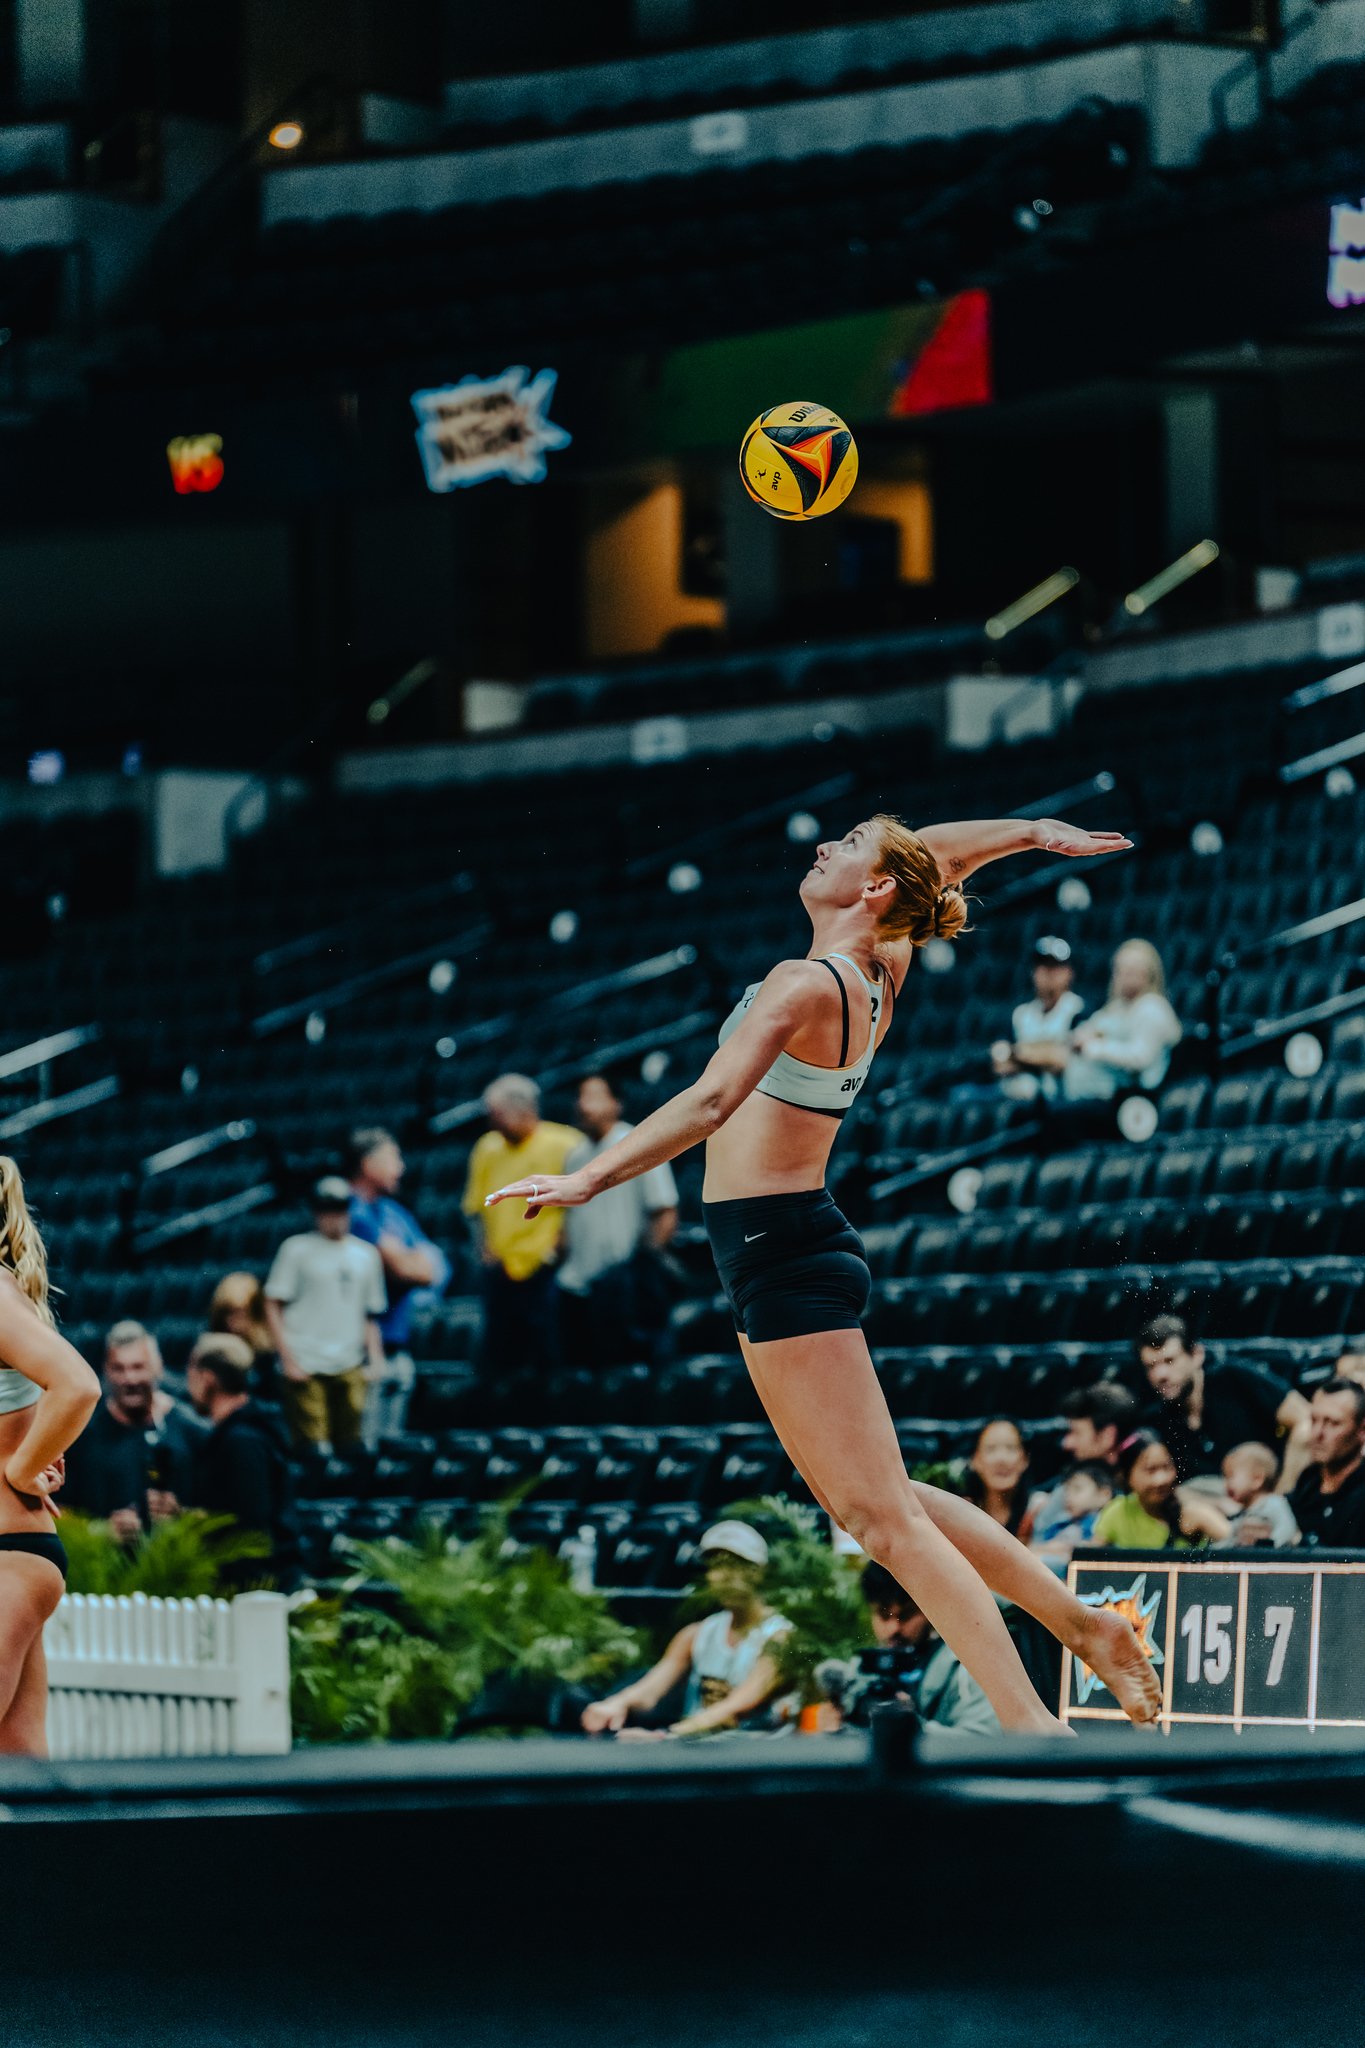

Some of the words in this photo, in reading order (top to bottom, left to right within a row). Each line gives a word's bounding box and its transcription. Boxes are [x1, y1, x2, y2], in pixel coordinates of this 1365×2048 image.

[788, 404, 823, 423] Wil
[771, 471, 782, 491] avp
[840, 1076, 862, 1092] av
[1181, 1604, 1233, 1685] 15
[1264, 1605, 1295, 1686] 7
